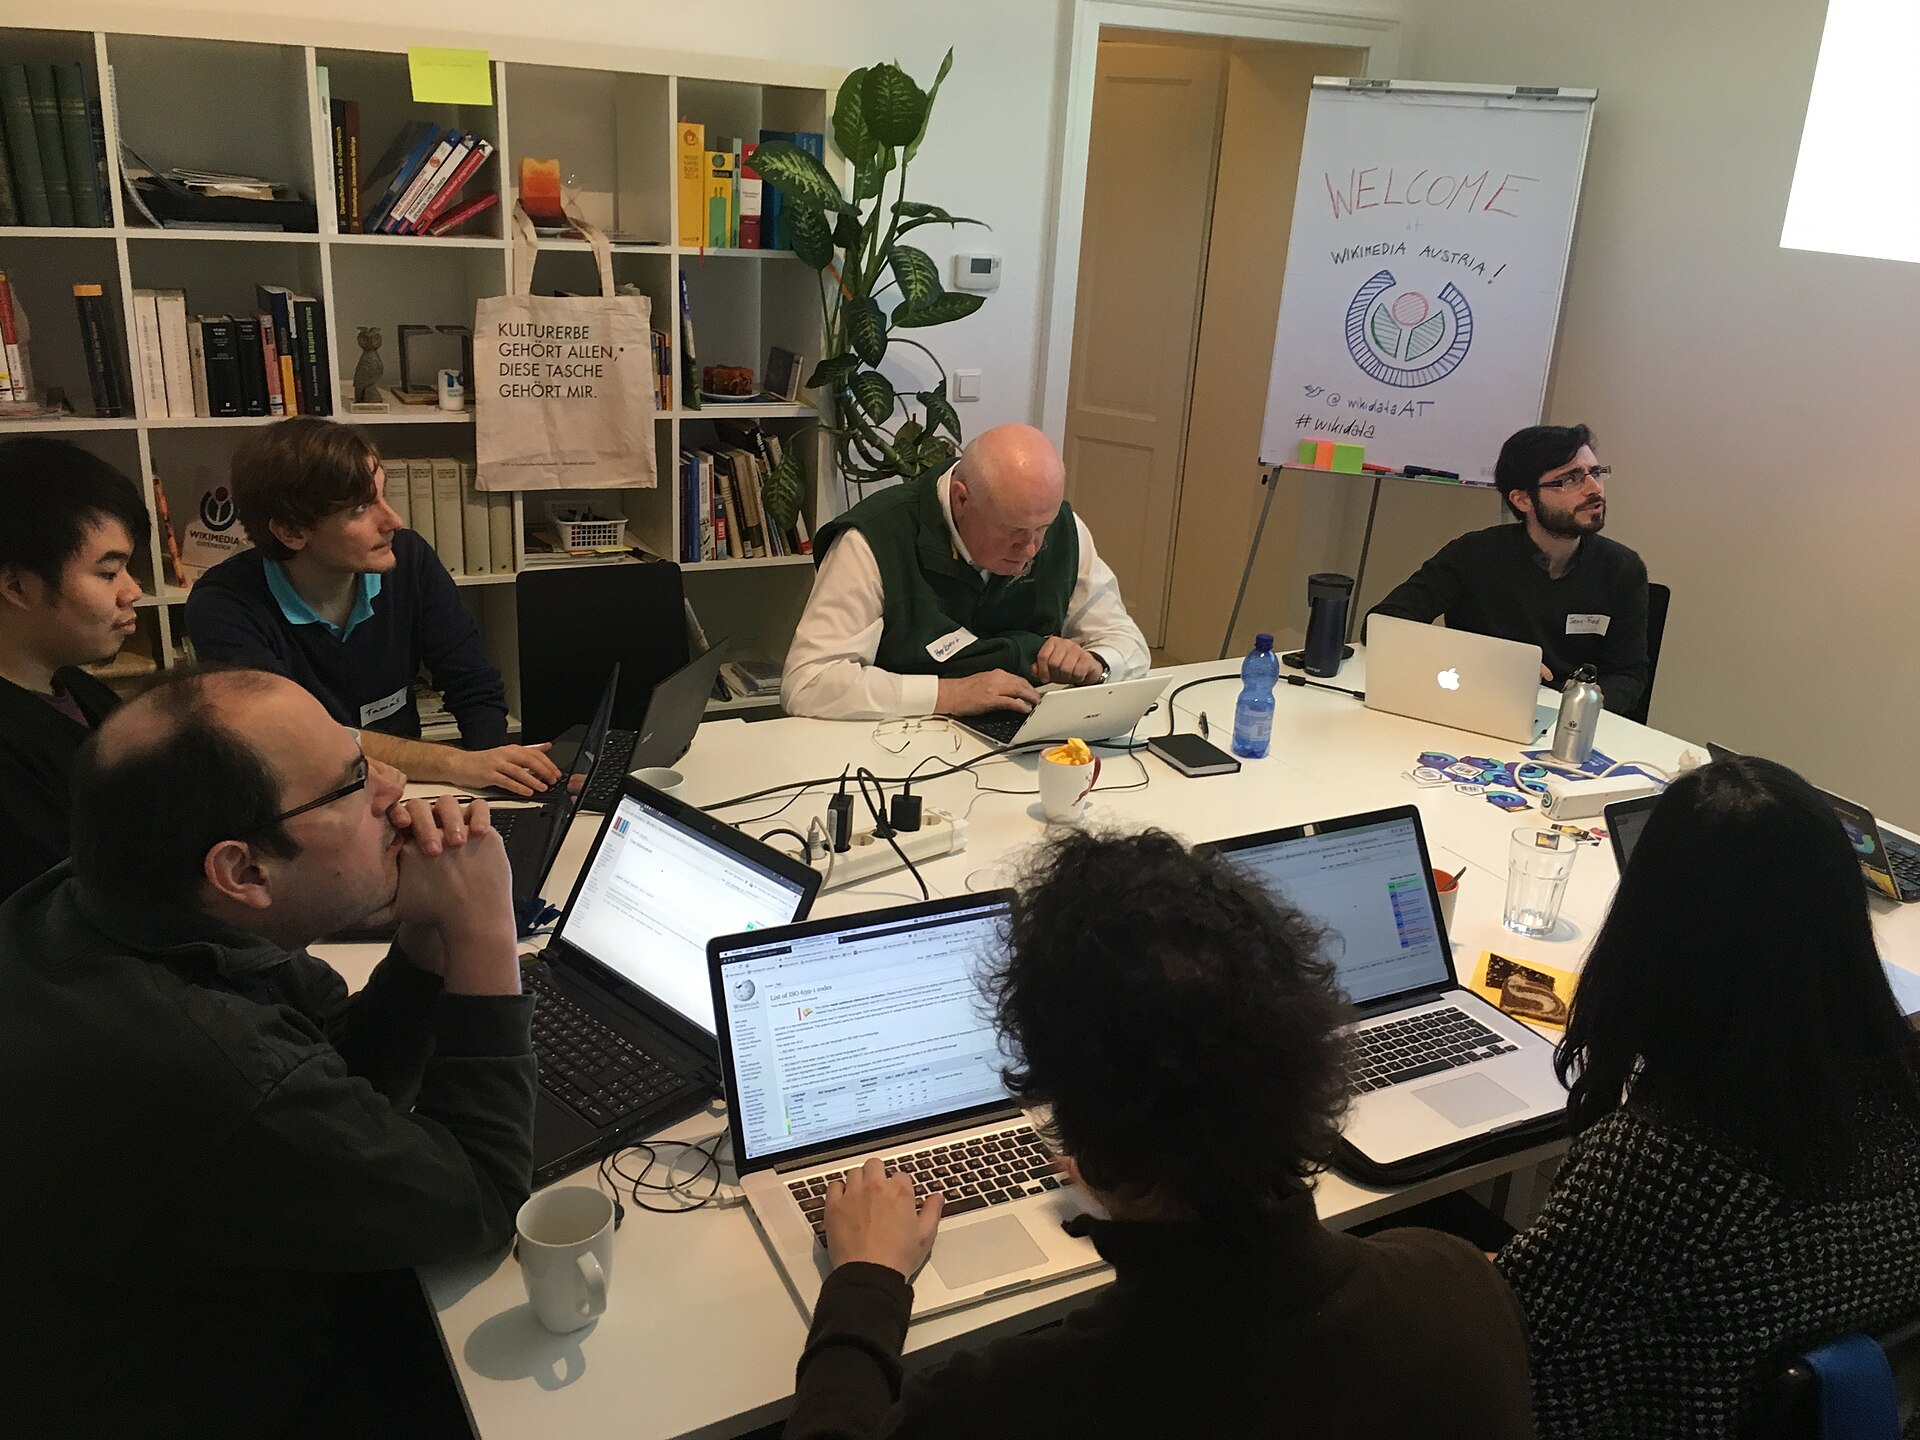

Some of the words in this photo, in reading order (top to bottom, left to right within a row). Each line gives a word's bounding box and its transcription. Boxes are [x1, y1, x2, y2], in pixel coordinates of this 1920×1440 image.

[1324, 167, 1540, 219] WELCOME
[1331, 242, 1407, 265] WIKIMEDIA
[1419, 244, 1507, 285] AUSTRIA!
[498, 323, 590, 340] KULTURERBE
[498, 340, 563, 359] GEHÖRT
[499, 362, 540, 377] DIESE
[546, 364, 603, 378] TASCHE
[498, 381, 562, 398] GEHÖRT
[566, 385, 598, 399] MIR.
[1295, 413, 1376, 439] #wikidata
[189, 529, 240, 547] WIKIMEDIA
[788, 990, 800, 998] ISO
[816, 984, 833, 992] codes
